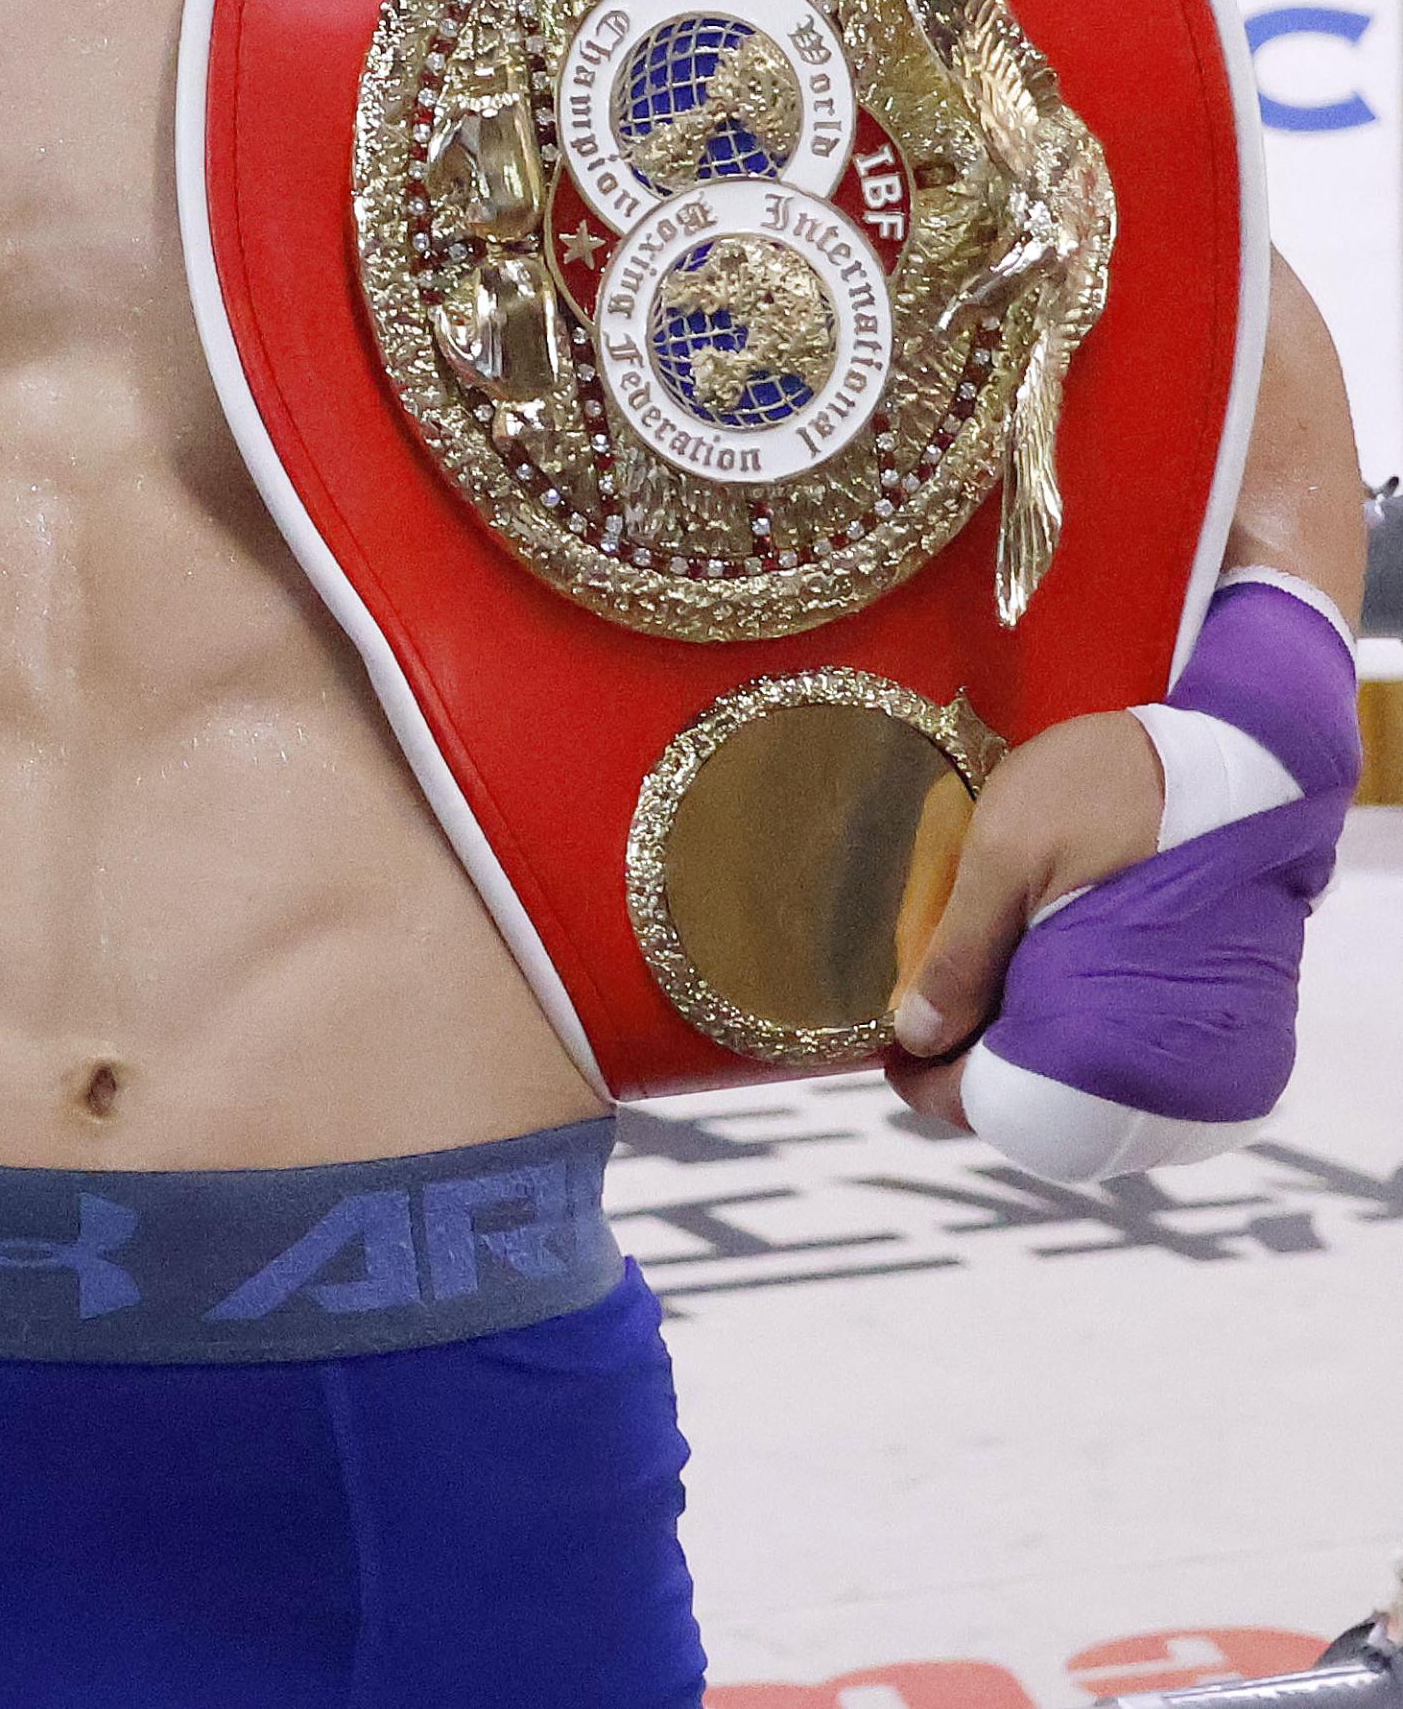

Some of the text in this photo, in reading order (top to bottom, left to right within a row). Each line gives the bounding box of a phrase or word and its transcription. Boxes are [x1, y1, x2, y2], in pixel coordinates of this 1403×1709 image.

[568, 8, 844, 219] World Champion
[855, 145, 905, 243] IBF
[600, 192, 884, 472] International Boxing Federation
